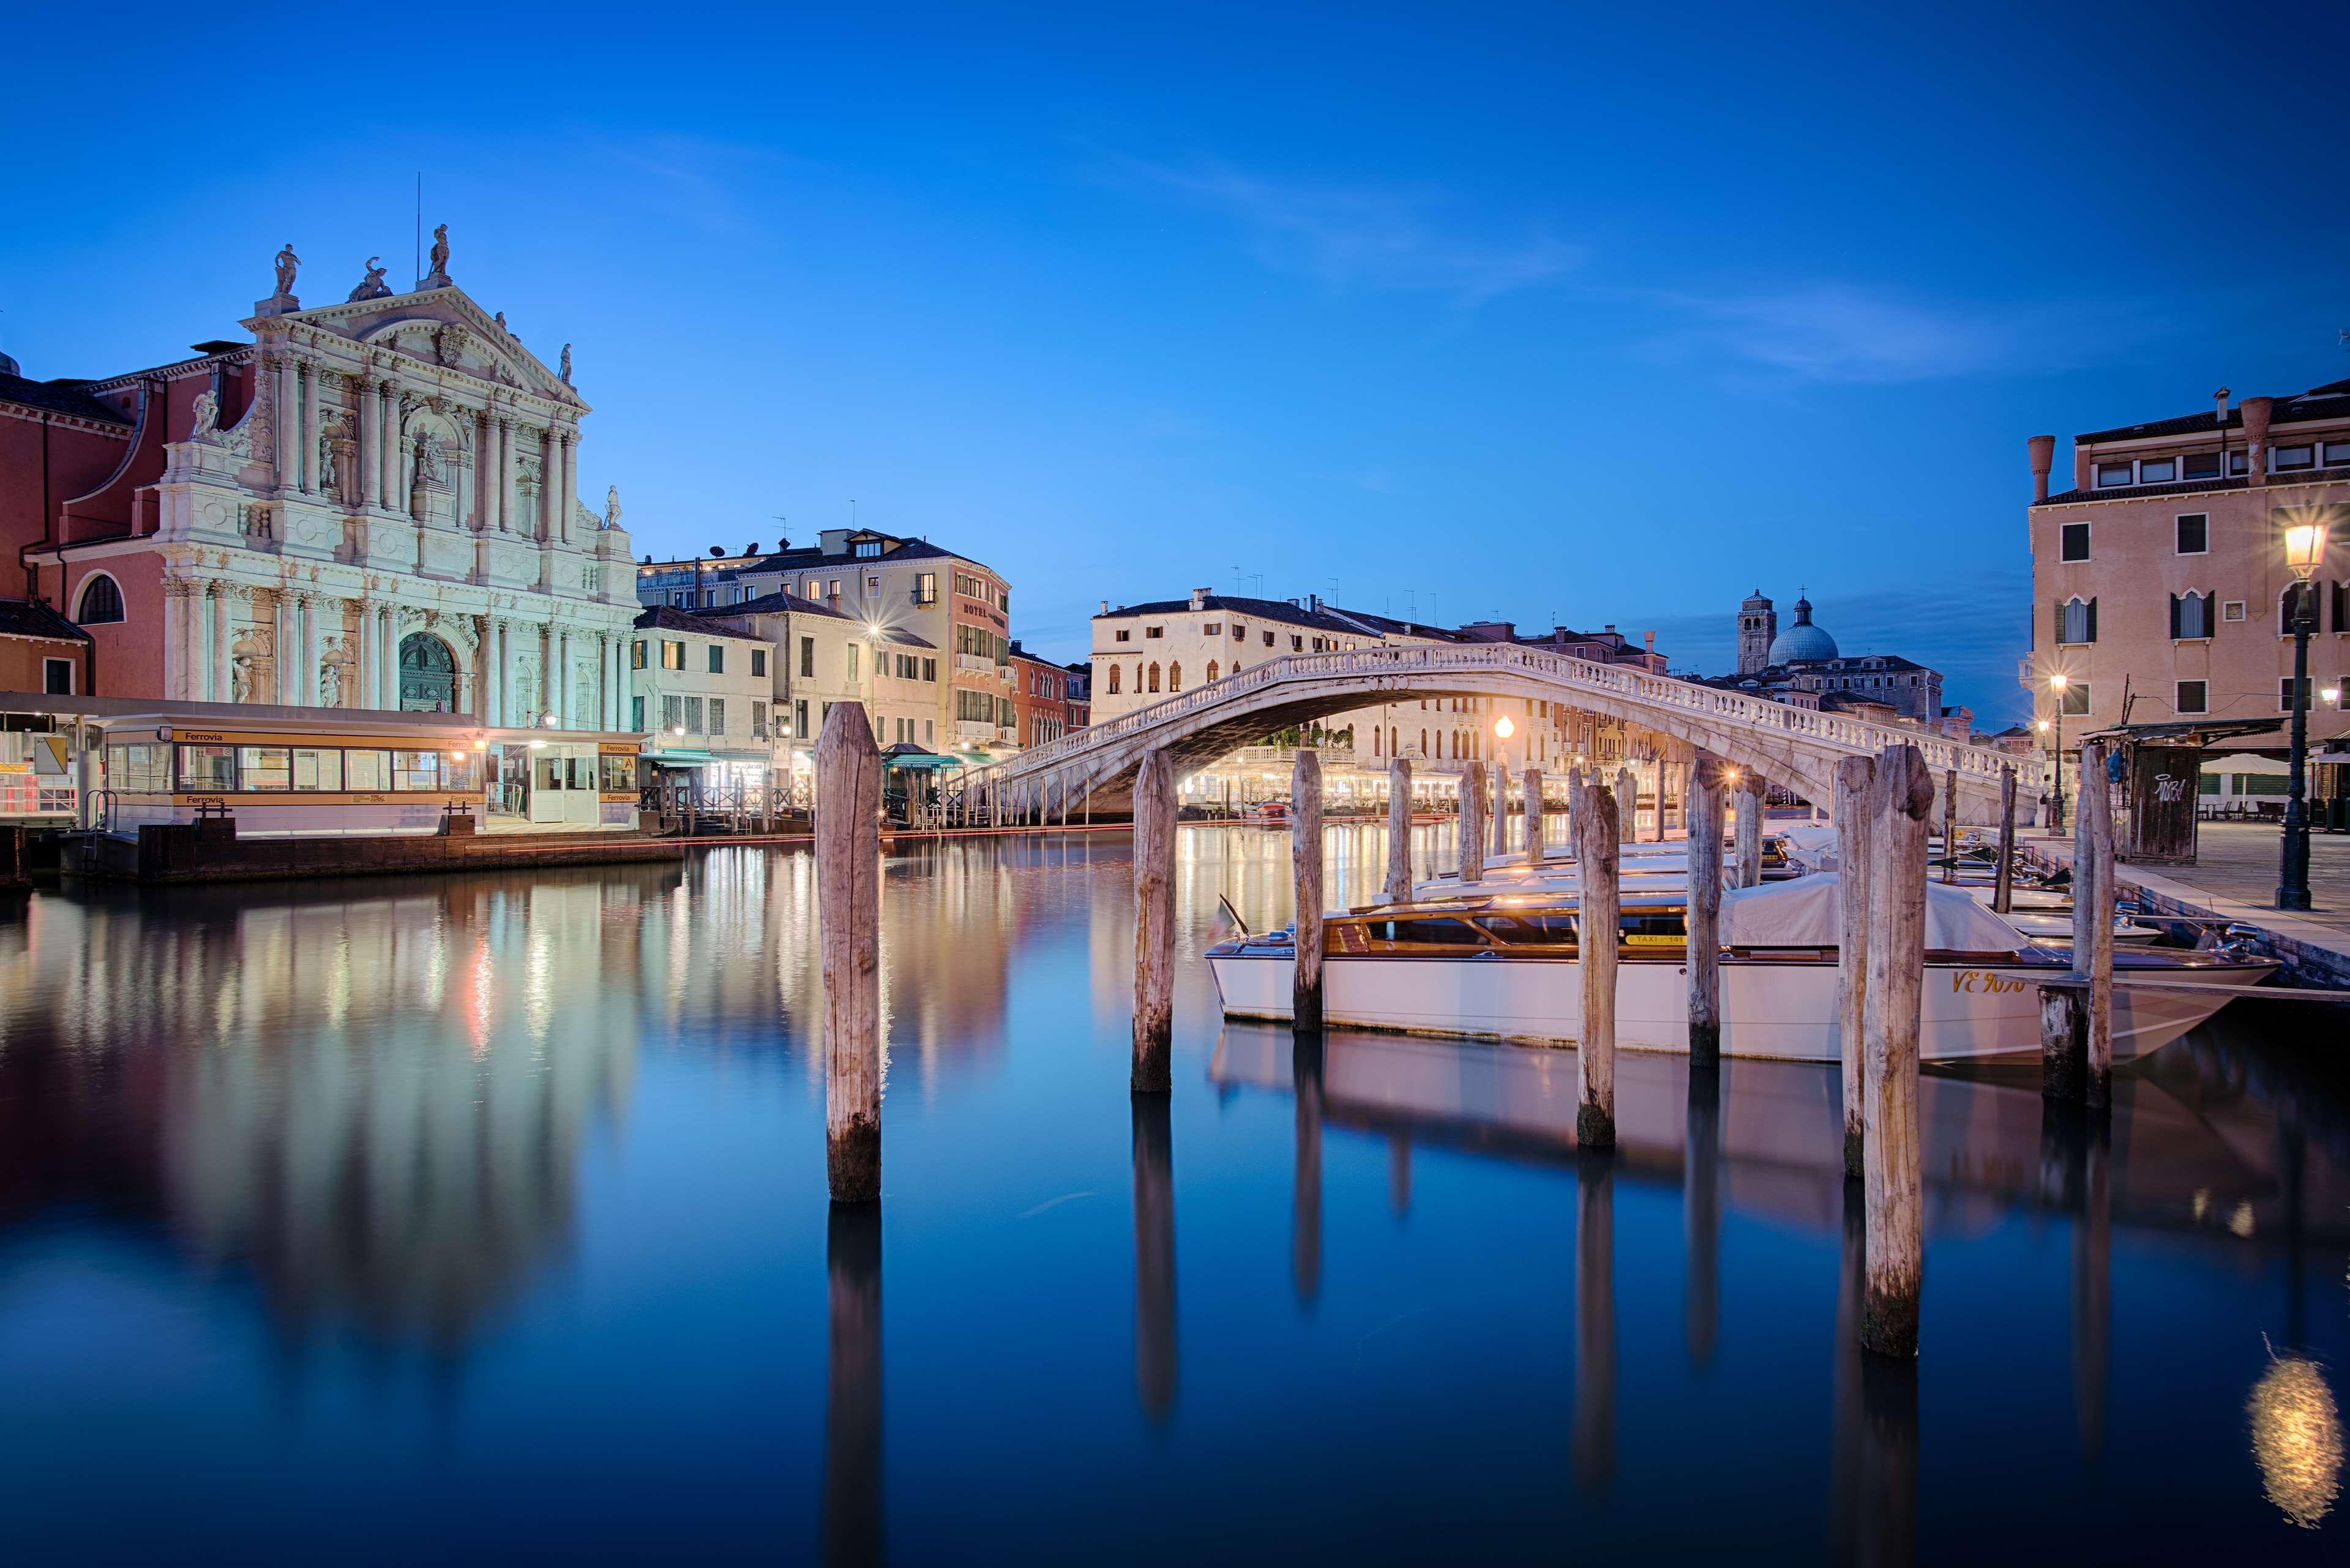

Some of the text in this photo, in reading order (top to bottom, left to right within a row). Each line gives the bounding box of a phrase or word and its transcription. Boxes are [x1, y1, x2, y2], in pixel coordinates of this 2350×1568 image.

[964, 603, 987, 618] HOTEL
[625, 758, 633, 768] A
[1953, 970, 1979, 993] VE
